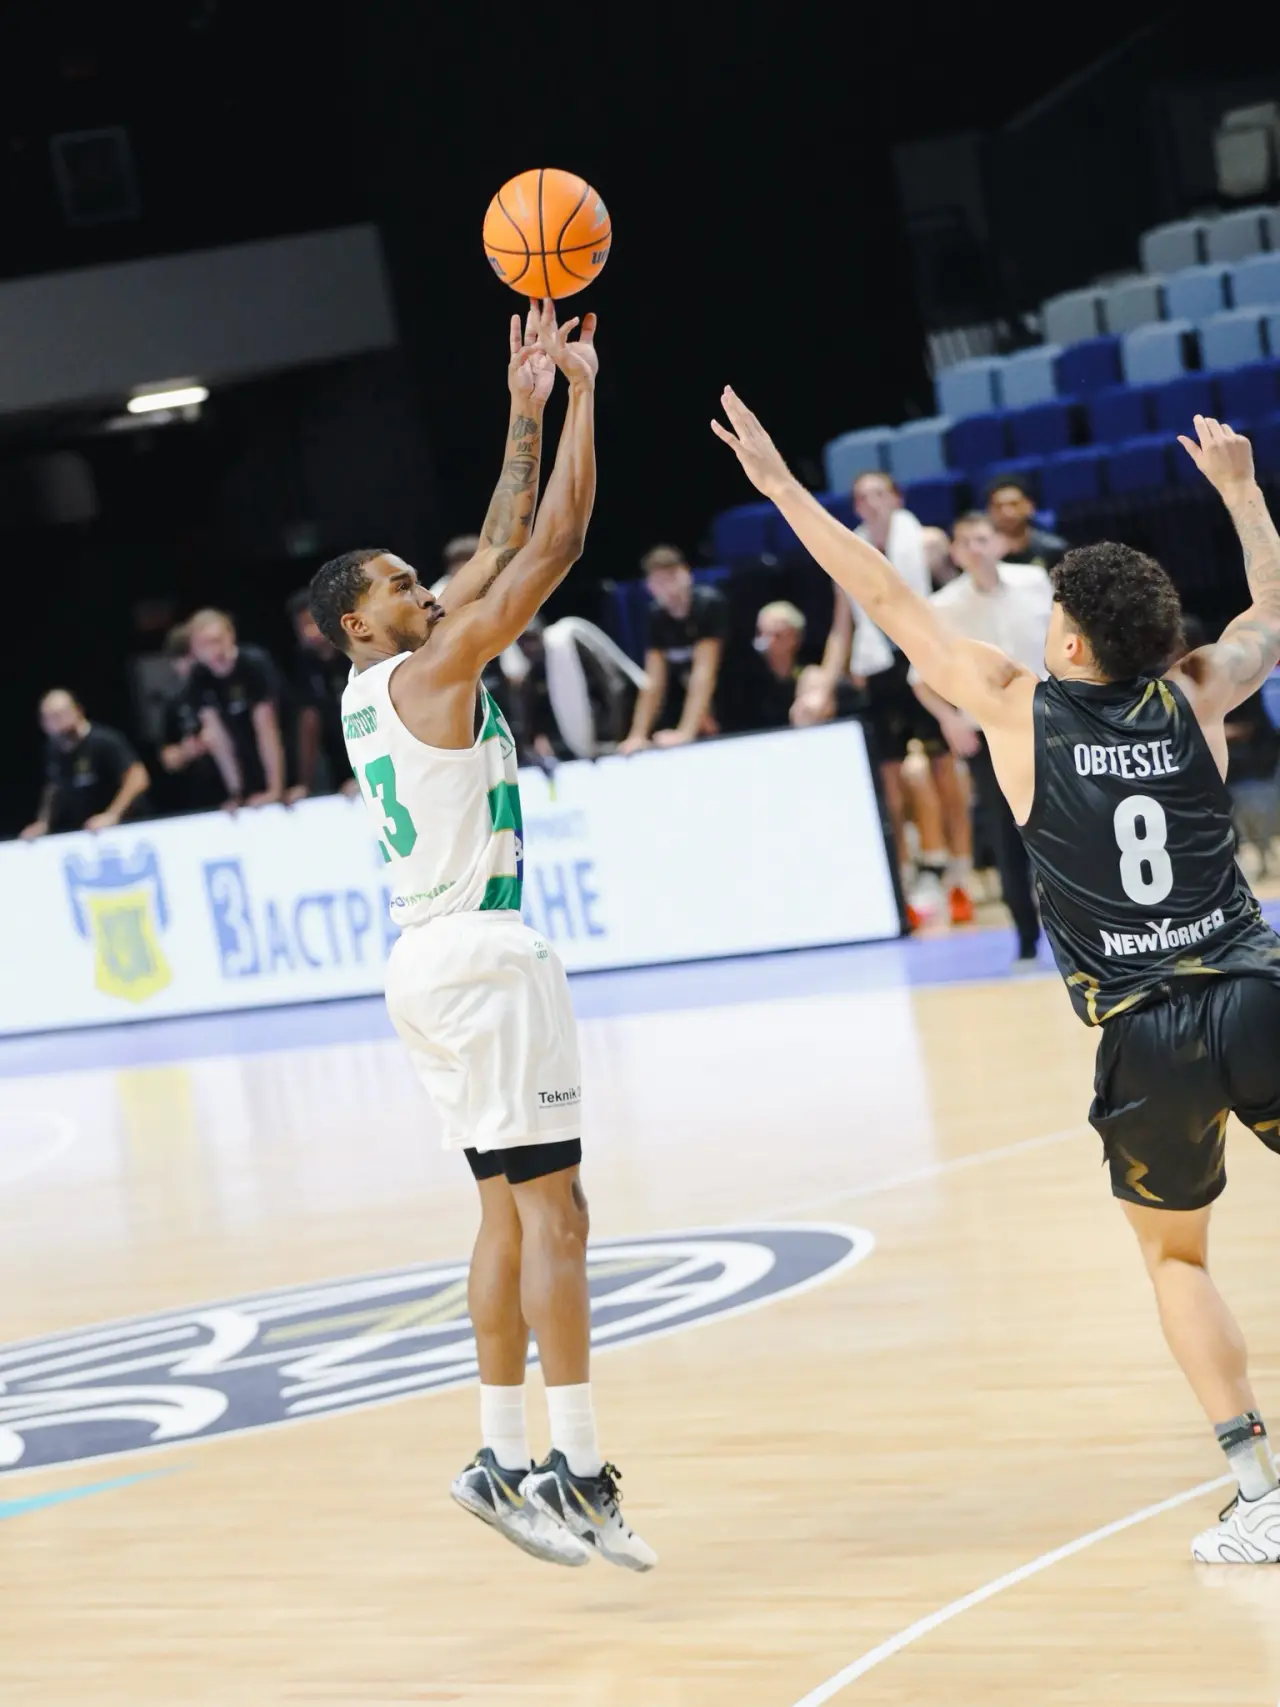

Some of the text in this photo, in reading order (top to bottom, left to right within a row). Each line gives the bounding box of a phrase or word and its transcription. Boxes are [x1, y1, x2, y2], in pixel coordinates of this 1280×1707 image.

[1074, 739, 1180, 779] OBIESIE
[1113, 794, 1174, 906] 8
[537, 1087, 577, 1104] Teknik
